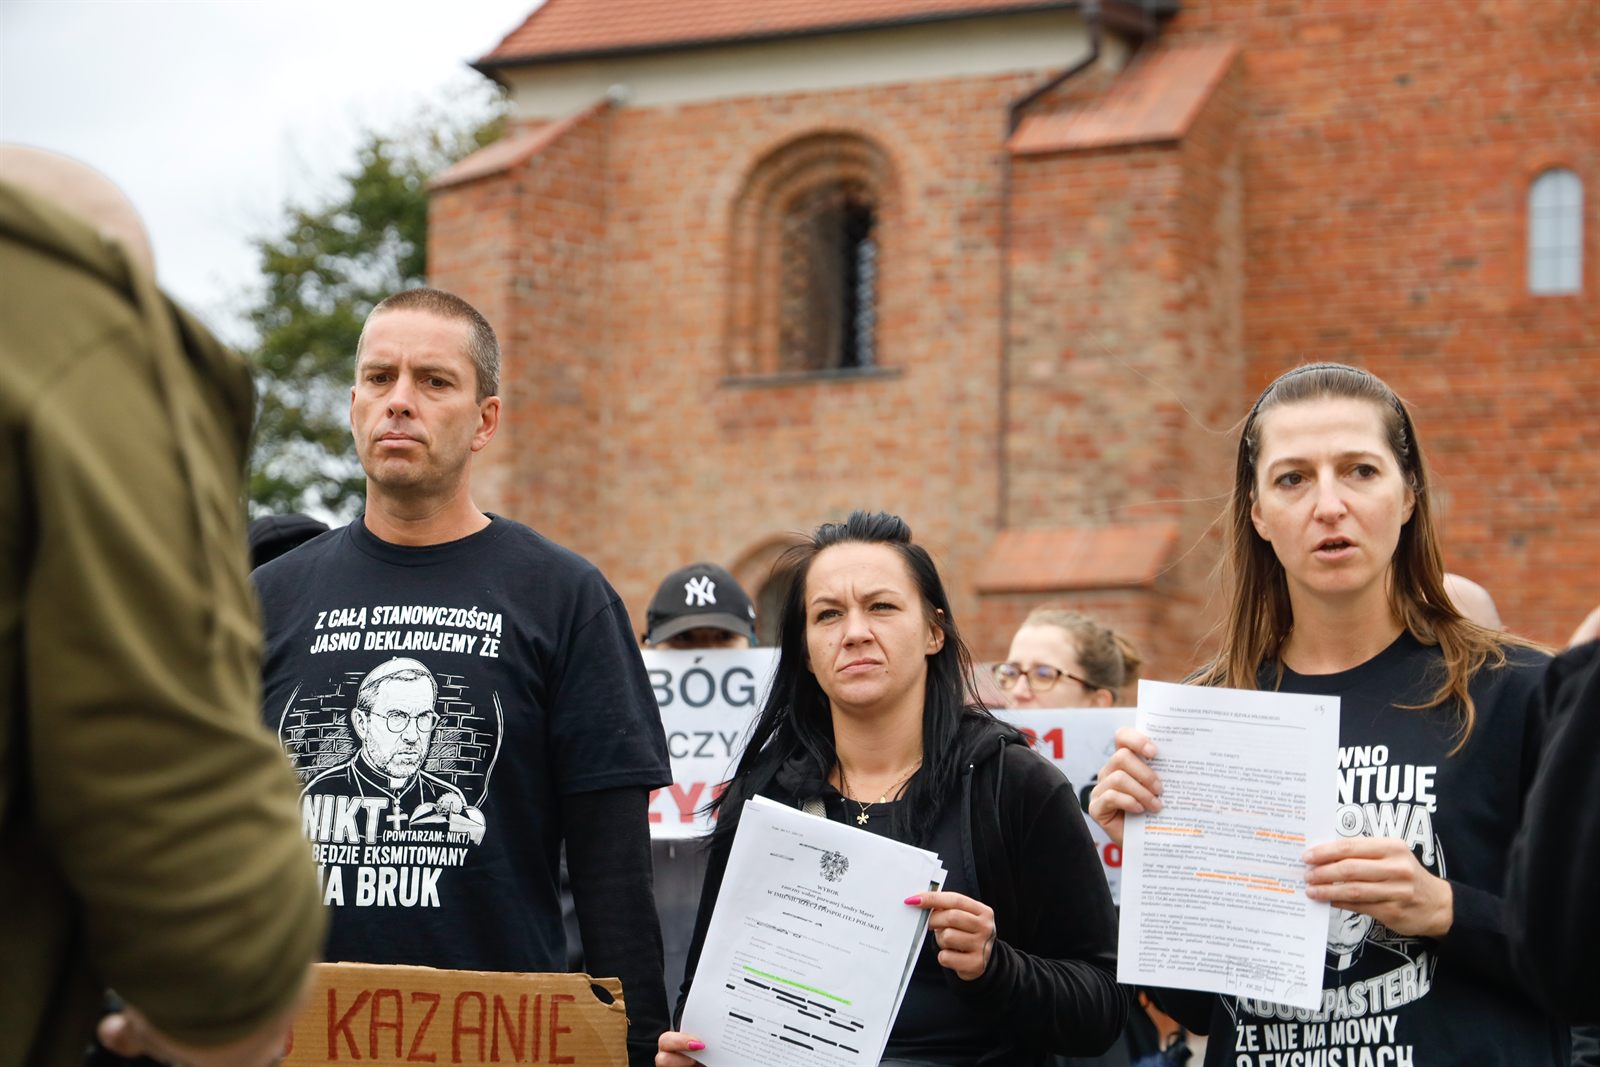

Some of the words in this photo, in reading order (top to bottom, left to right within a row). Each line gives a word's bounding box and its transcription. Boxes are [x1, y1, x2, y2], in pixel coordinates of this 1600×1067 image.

[314, 611, 328, 630] Z
[328, 607, 367, 629] CAŁĄ
[370, 605, 502, 637] STANOWCZOŚCIĄ
[310, 631, 361, 654] JASNO
[364, 631, 477, 654] DEKLARUJEMY
[479, 633, 501, 658] ŻE
[648, 656, 755, 708] BÓG
[1337, 744, 1389, 769] WNO
[1337, 764, 1437, 813] NTUJĘ
[302, 794, 389, 844] NIKT
[382, 829, 445, 843] (POWTARZAM:
[446, 831, 471, 845] NIKT)
[1336, 802, 1435, 866] OWĄ
[312, 843, 359, 867] BĘDZIE
[363, 846, 468, 866] EKSMITOWANY
[355, 866, 443, 907] BRUK
[327, 987, 576, 1064] KAZANIE
[1263, 1022, 1298, 1051] NIE
[1303, 1023, 1326, 1049] MA
[1330, 1015, 1398, 1046] MOWY
